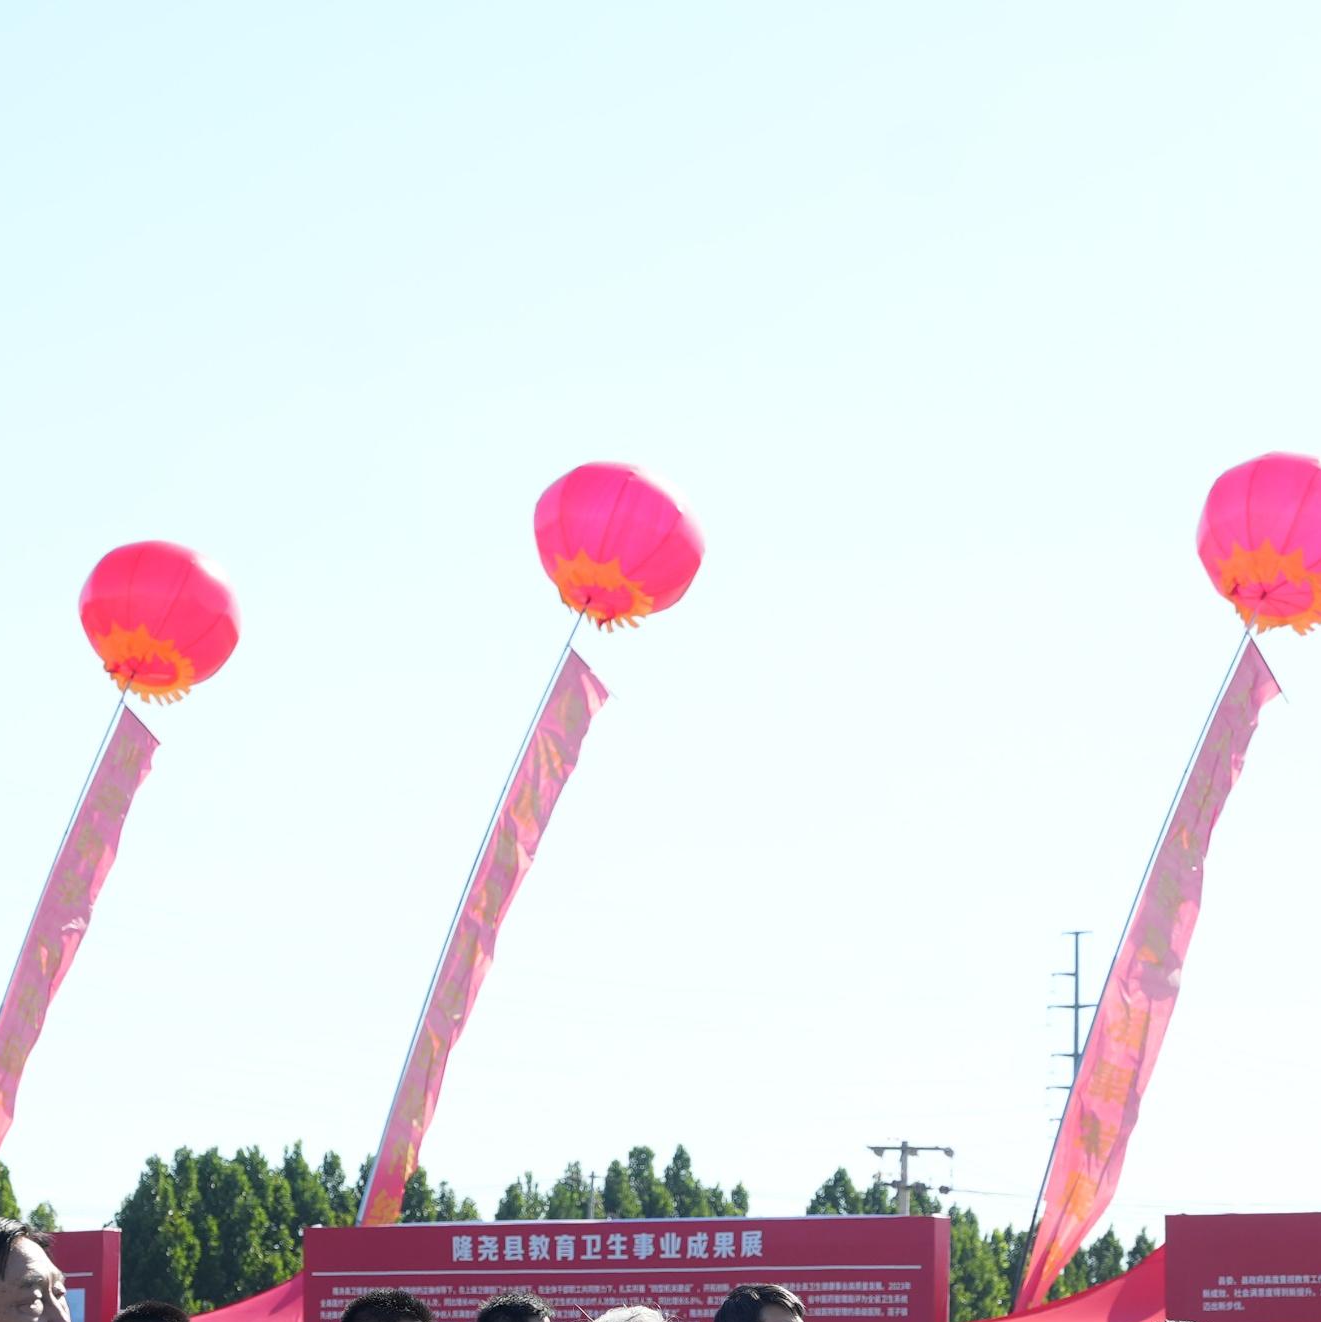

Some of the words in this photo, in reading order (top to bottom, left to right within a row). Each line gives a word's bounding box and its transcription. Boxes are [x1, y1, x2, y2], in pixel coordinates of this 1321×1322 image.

[451, 1230, 764, 1263] 隆尧县教育卫生事业成果展
